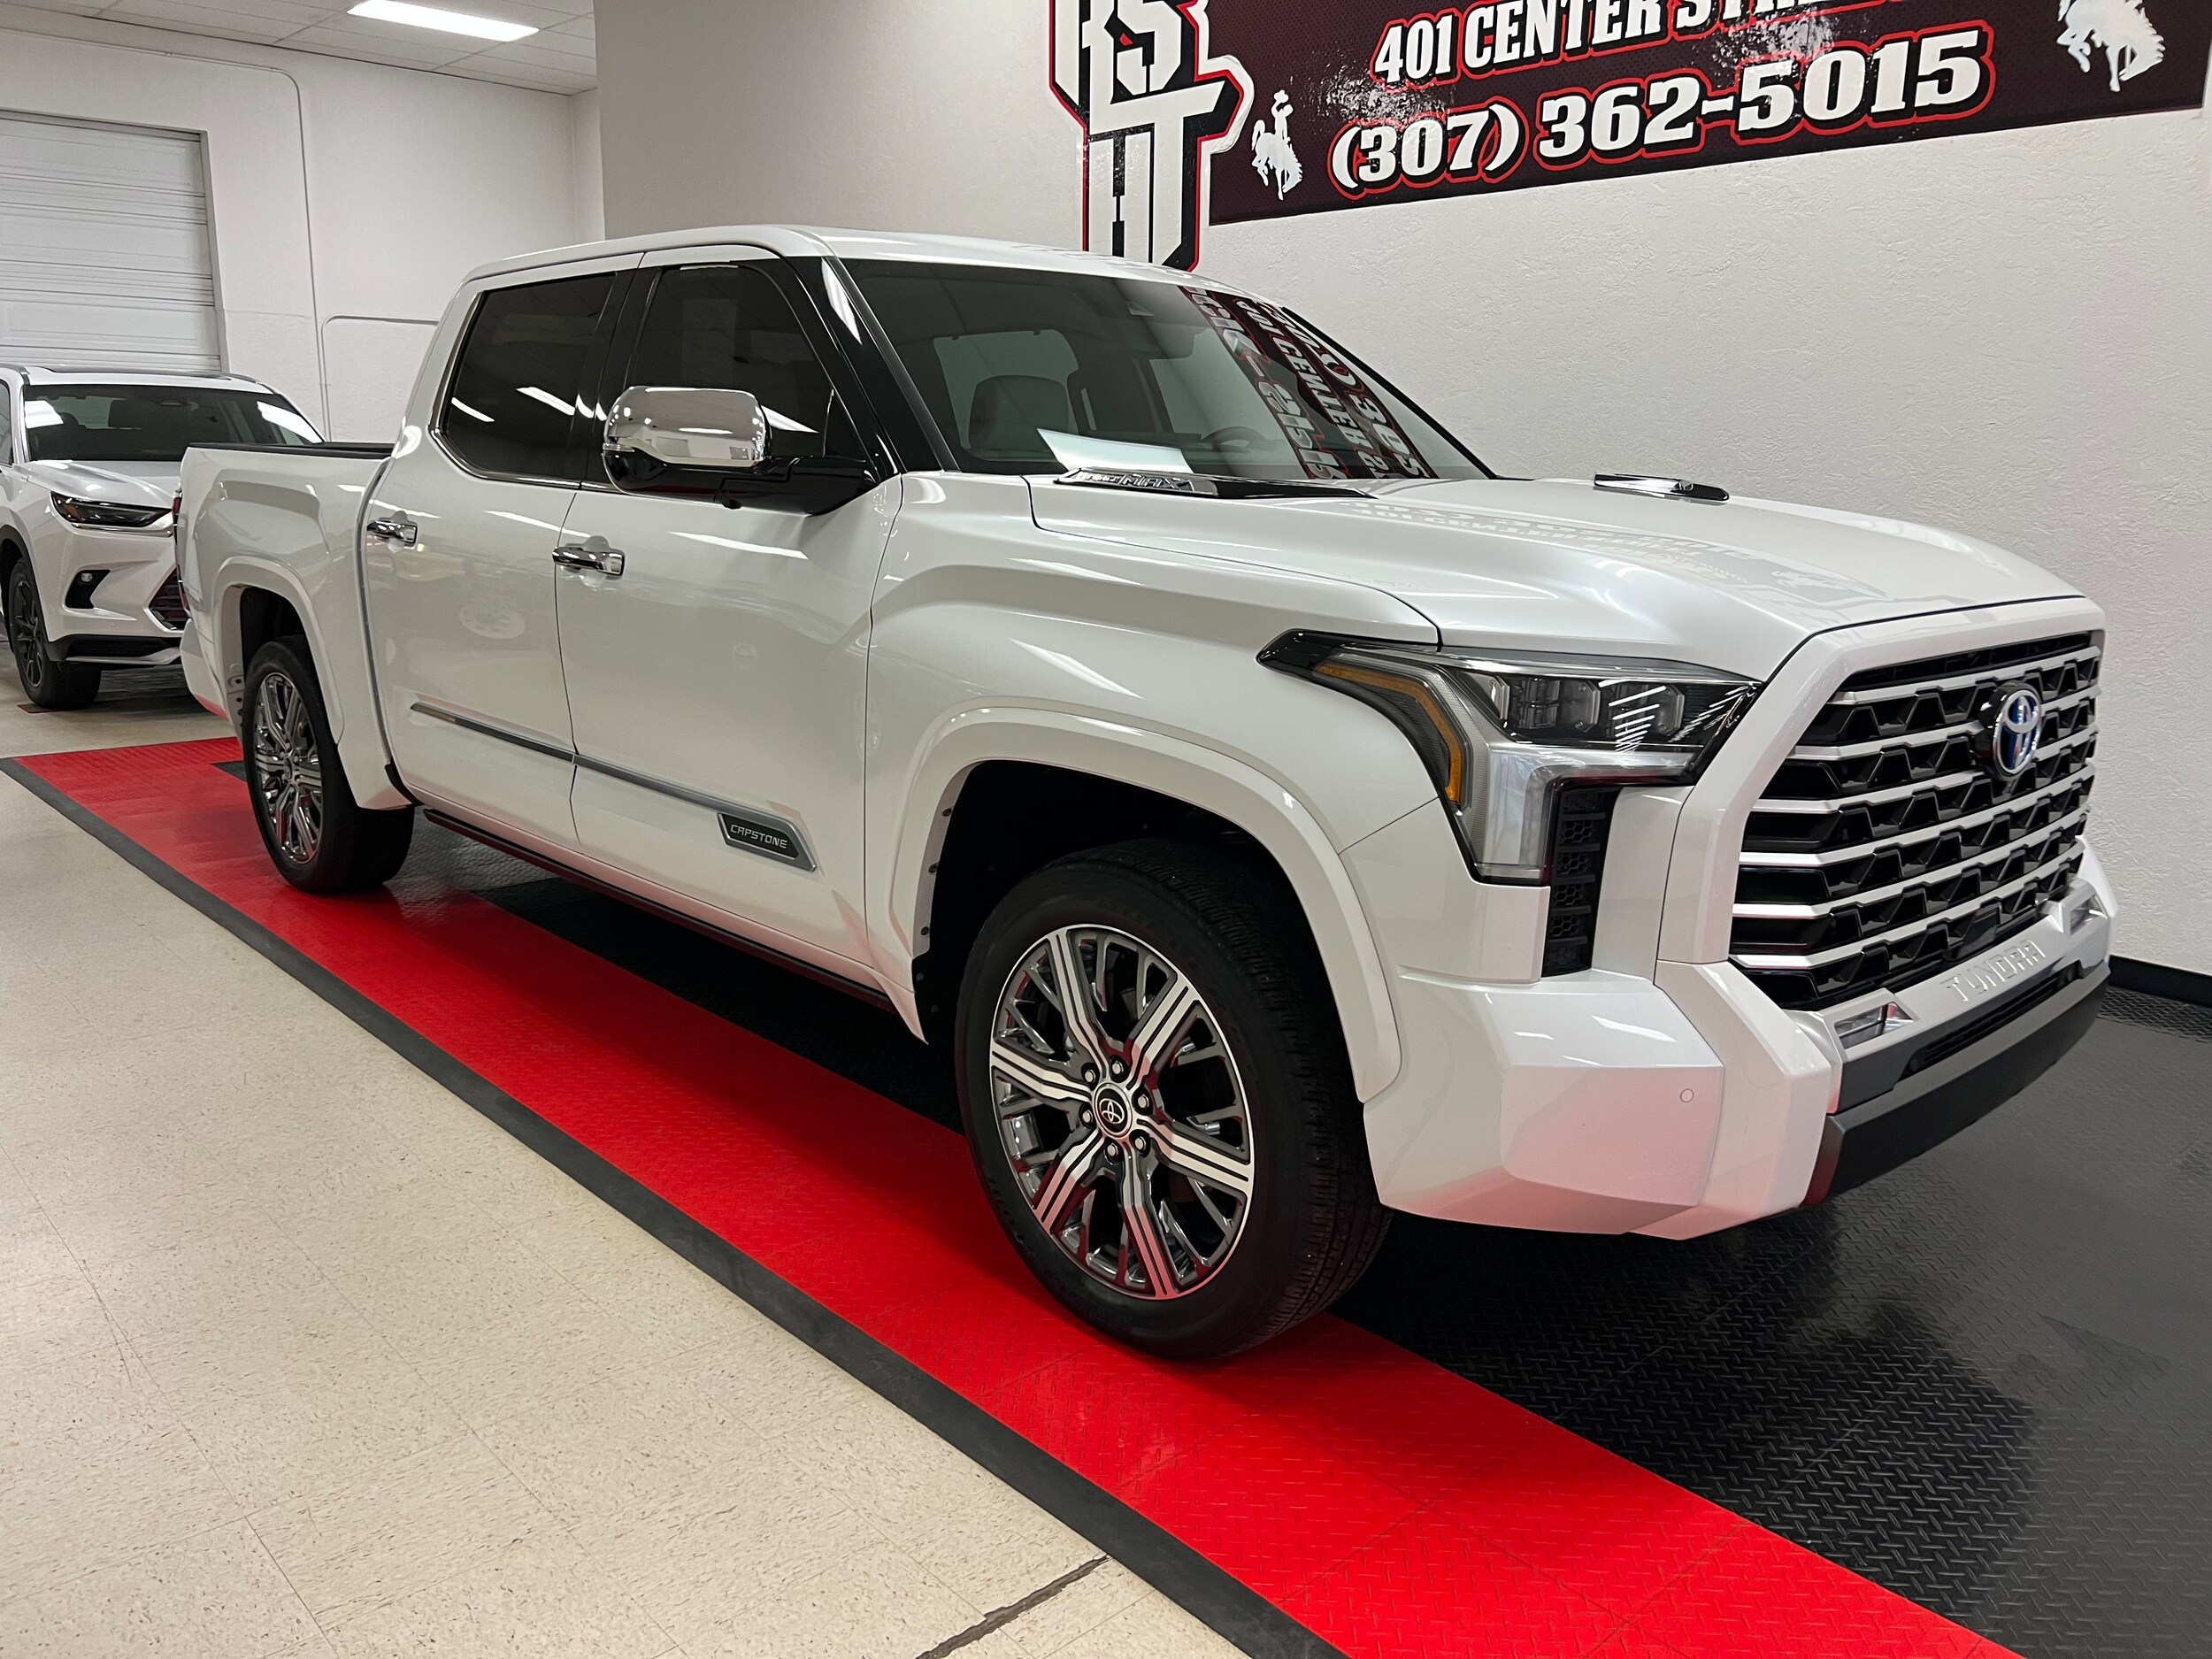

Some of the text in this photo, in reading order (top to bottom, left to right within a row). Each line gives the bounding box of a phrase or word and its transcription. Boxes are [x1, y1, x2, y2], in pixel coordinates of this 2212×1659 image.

[1374, 15, 1453, 83] 401
[1463, 0, 1662, 68] CENTER
[1333, 30, 1981, 188] (307) 362-5015
[730, 824, 788, 849] CAPSTONE
[1939, 938, 2047, 1002] TUNDRA
